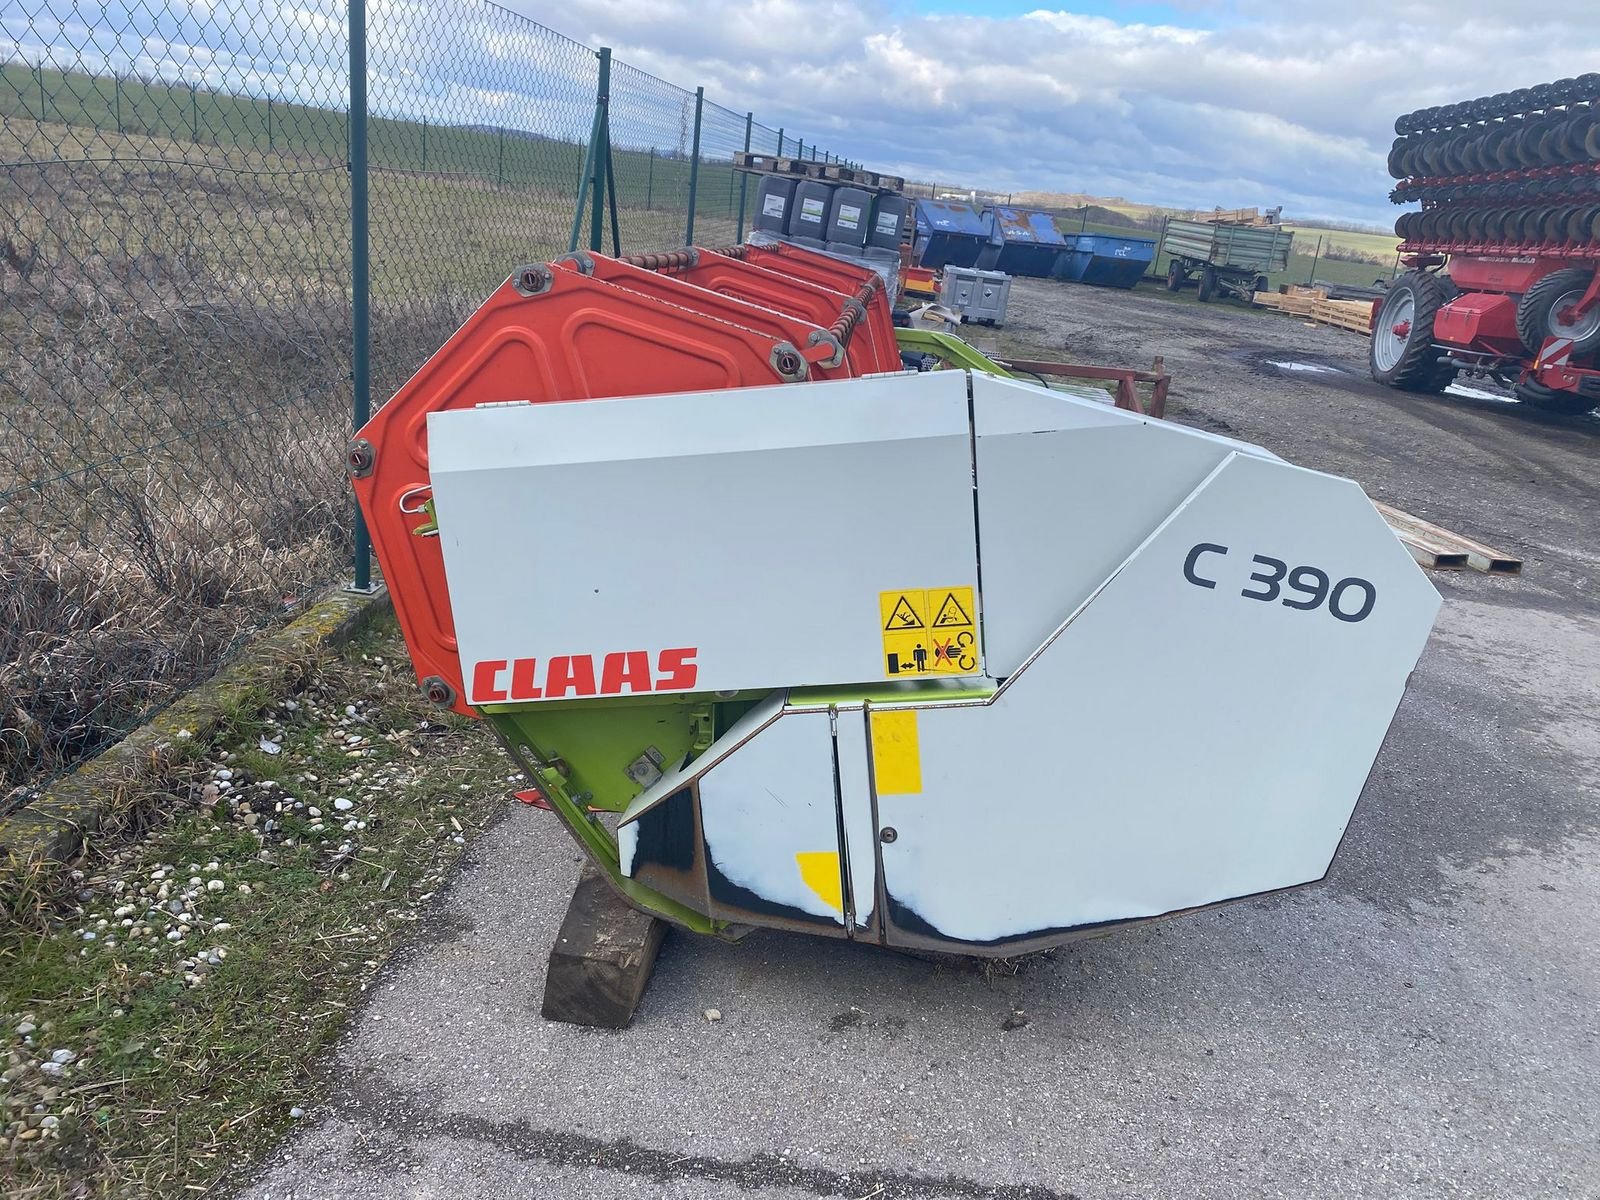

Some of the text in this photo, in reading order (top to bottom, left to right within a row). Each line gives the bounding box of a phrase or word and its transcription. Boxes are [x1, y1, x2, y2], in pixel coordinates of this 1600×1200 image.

[1183, 542, 1377, 623] C 390
[472, 647, 698, 702] CLAAS
